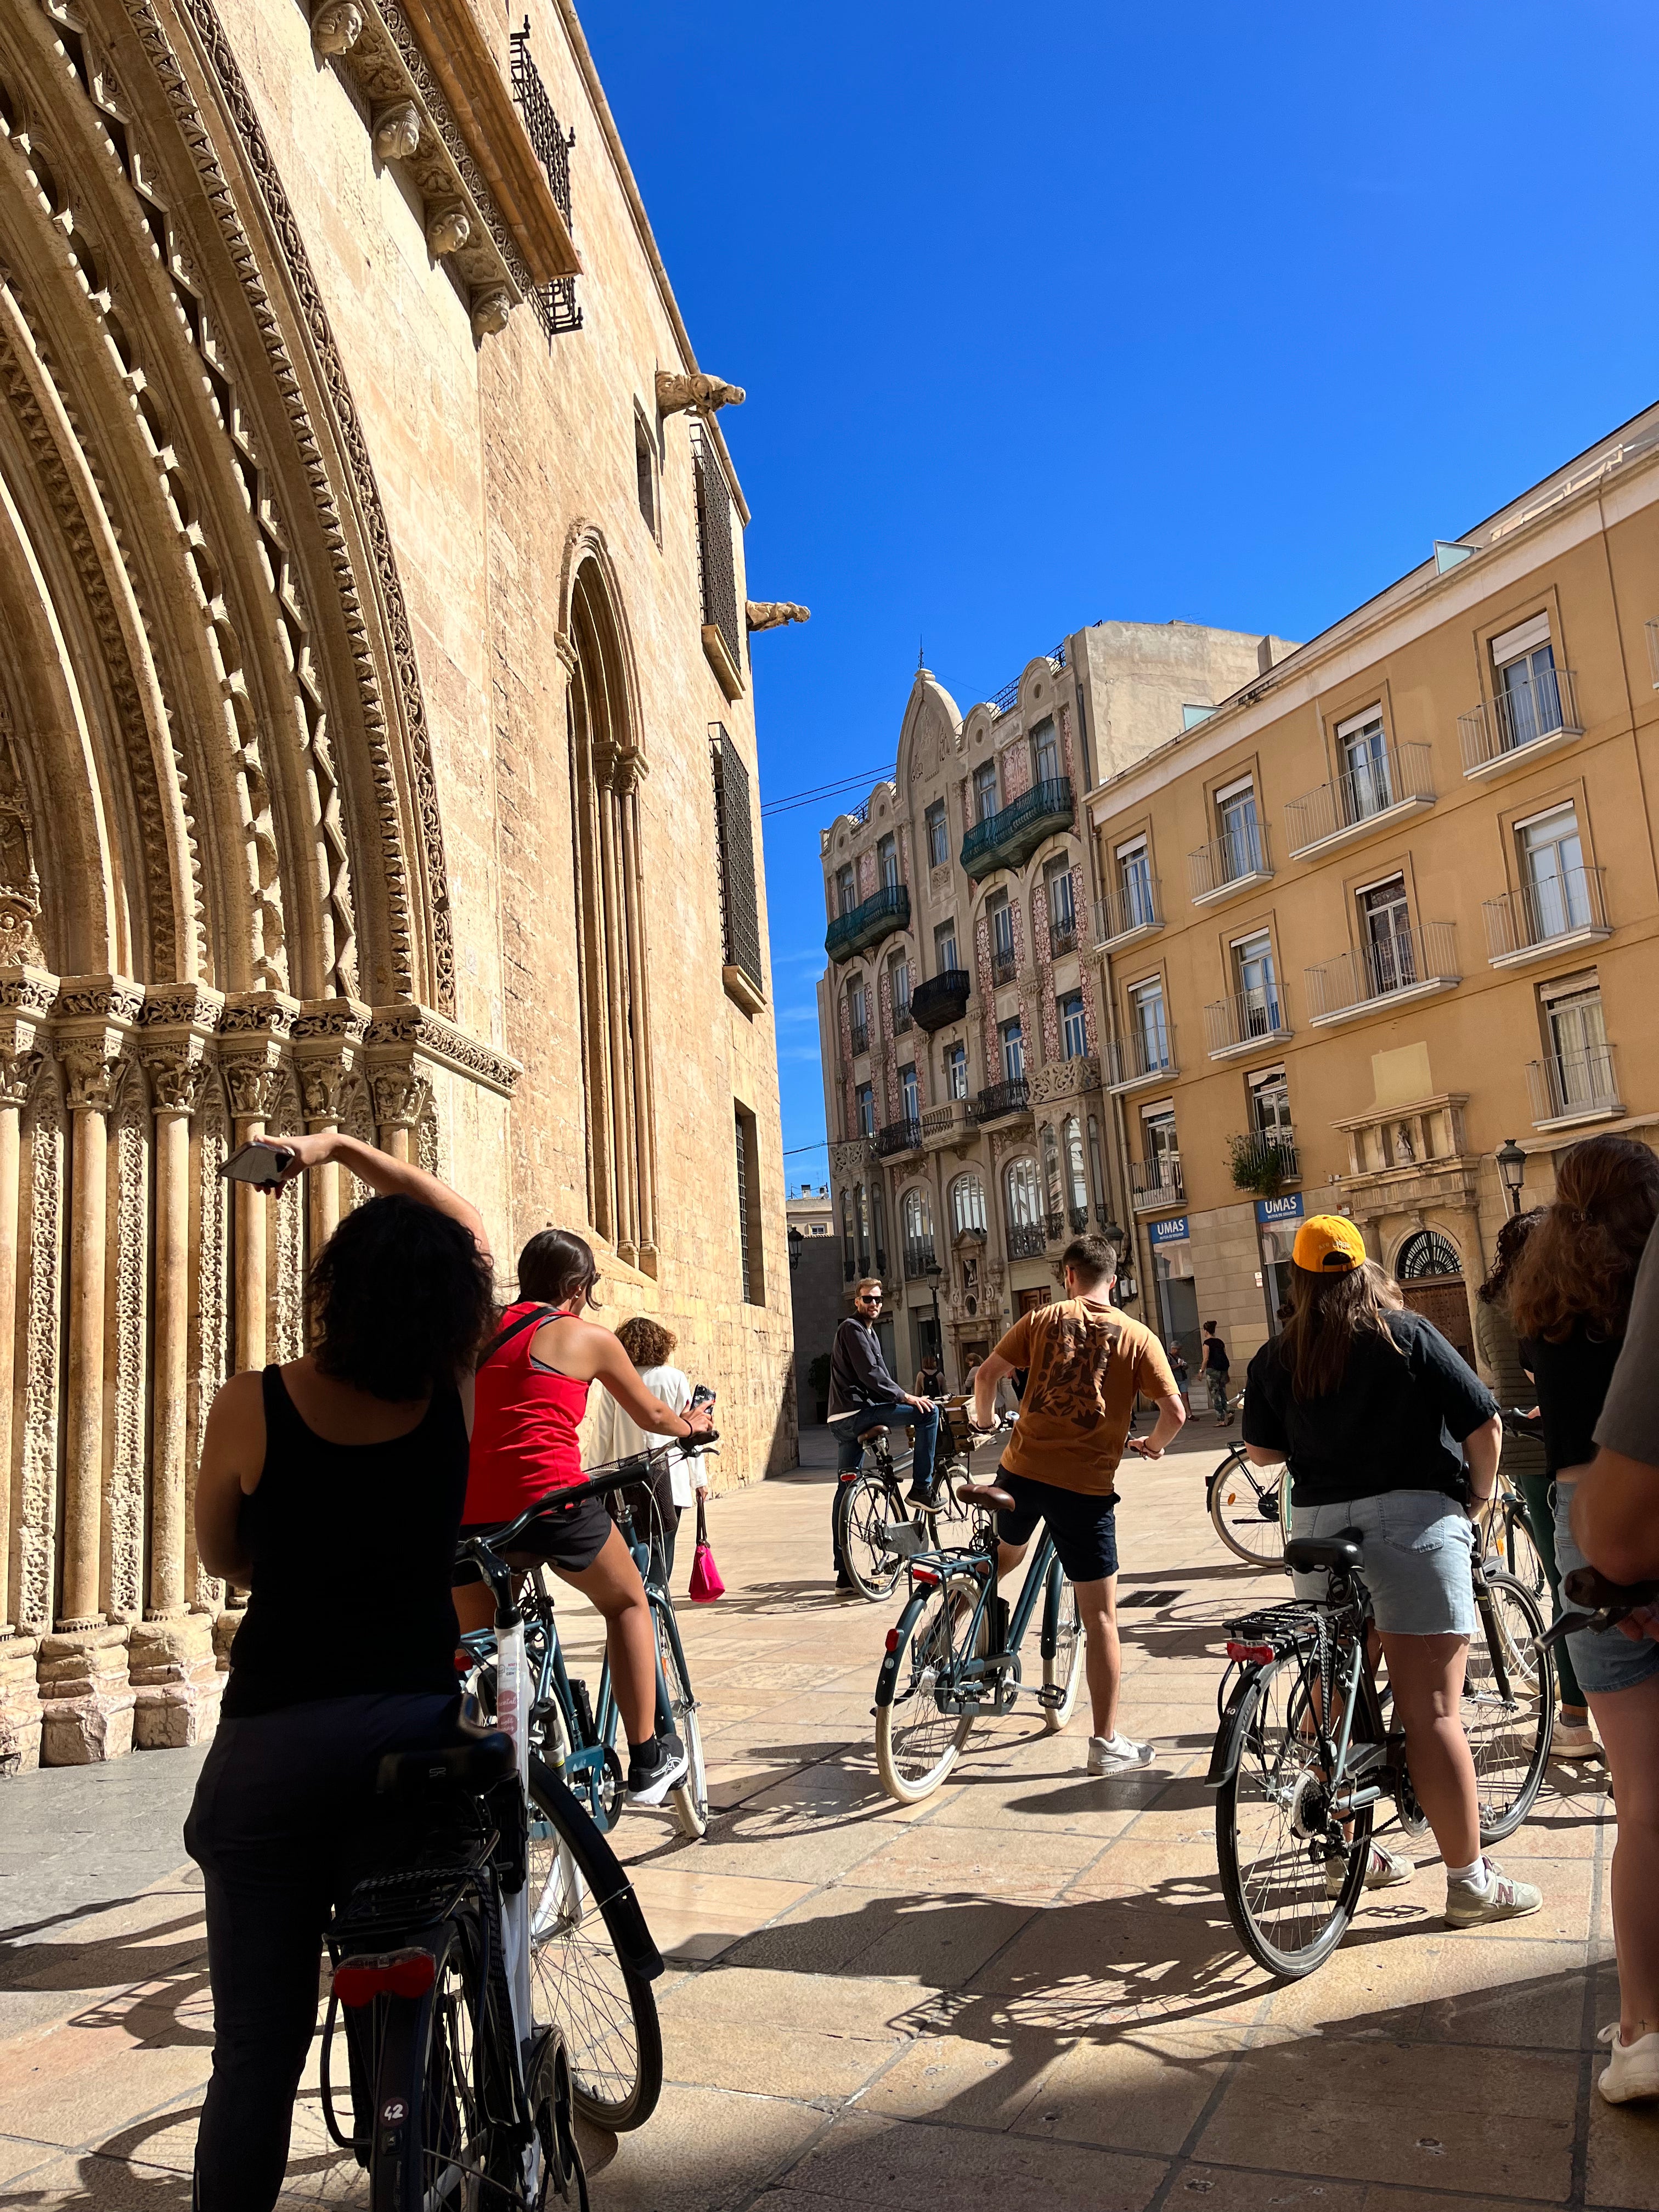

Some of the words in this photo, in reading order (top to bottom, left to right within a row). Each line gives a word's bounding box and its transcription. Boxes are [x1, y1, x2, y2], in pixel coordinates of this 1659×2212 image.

[1265, 1197, 1297, 1214] UMAS
[1157, 1219, 1184, 1235] UMAS
[1497, 1882, 1514, 1904] N
[385, 2104, 403, 2121] 42
